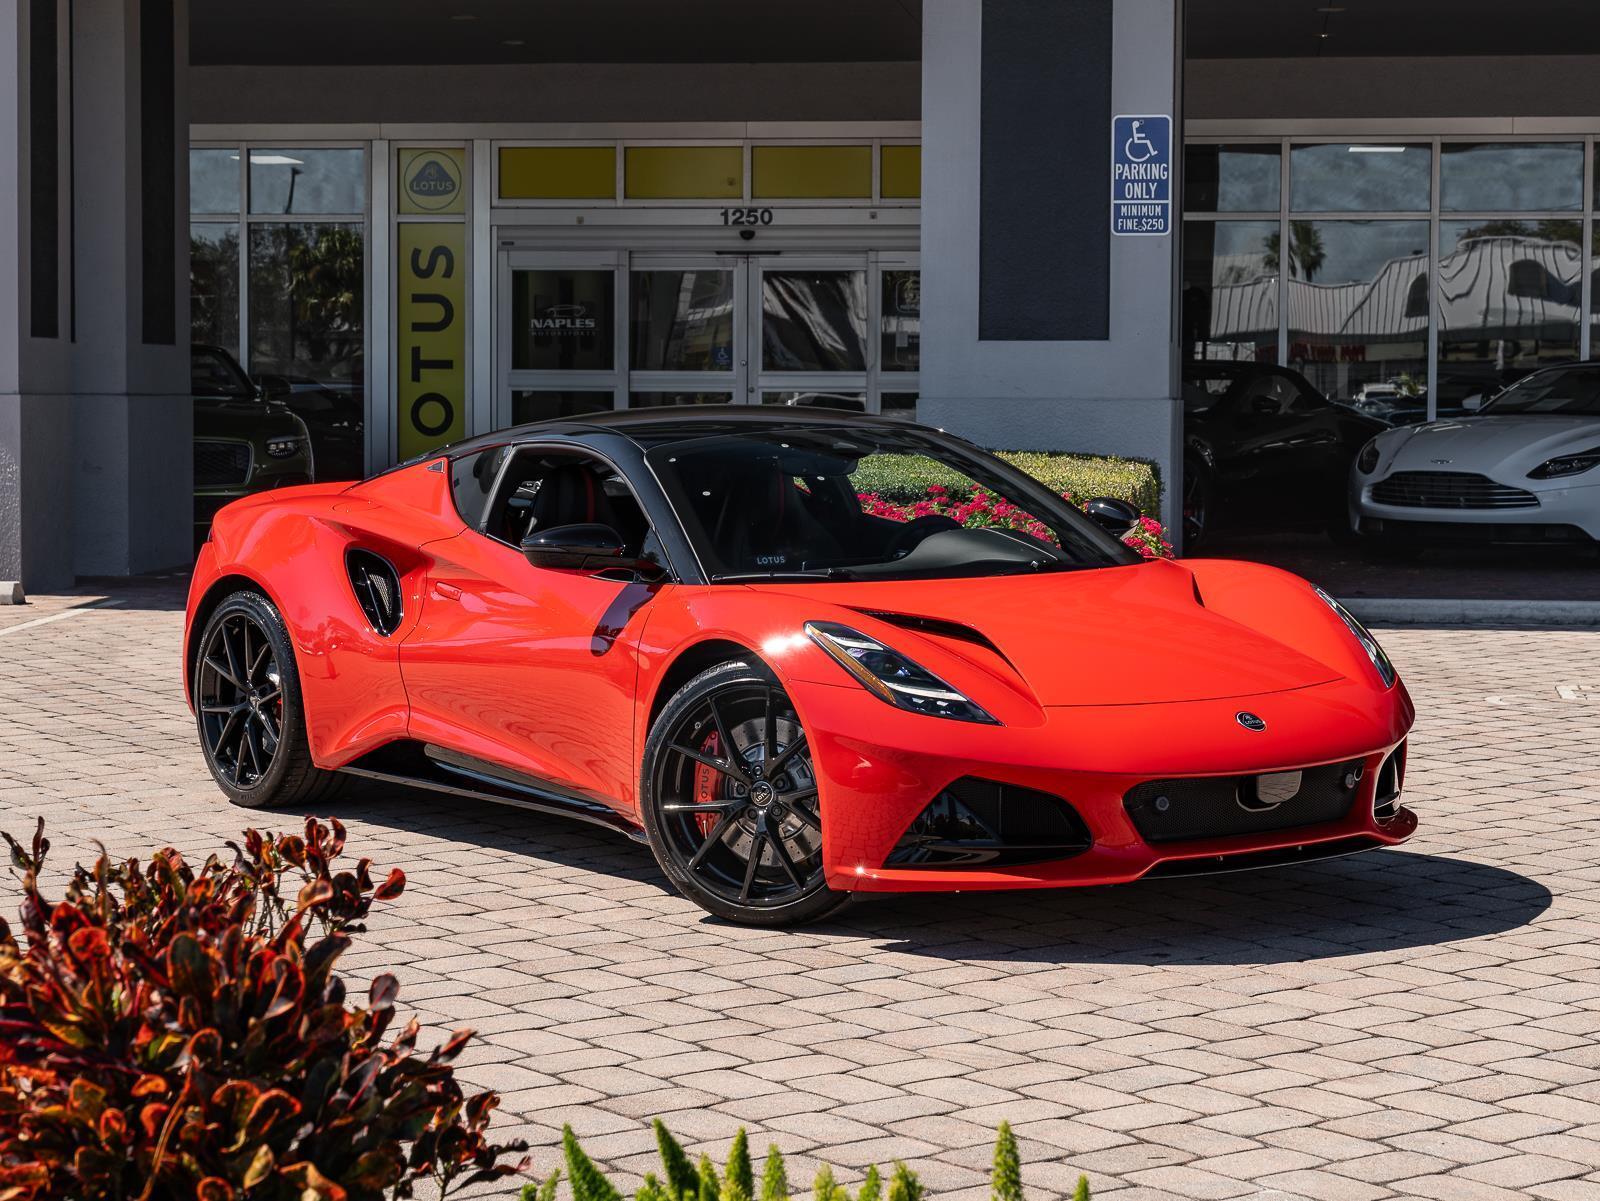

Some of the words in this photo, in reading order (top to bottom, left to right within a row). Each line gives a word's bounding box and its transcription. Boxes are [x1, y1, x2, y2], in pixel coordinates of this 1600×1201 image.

[1115, 163, 1168, 180] PARKING
[413, 181, 453, 191] LOTUS
[1125, 182, 1158, 199] ONLY
[720, 208, 774, 226] 1250
[1120, 204, 1162, 217] MINIMUM
[1118, 218, 1139, 231] FINE
[1141, 218, 1164, 231] $250
[530, 318, 596, 328] NAPLES
[411, 245, 454, 437] OTUS
[756, 555, 786, 565] LOTUS
[701, 768, 711, 801] OTUS
